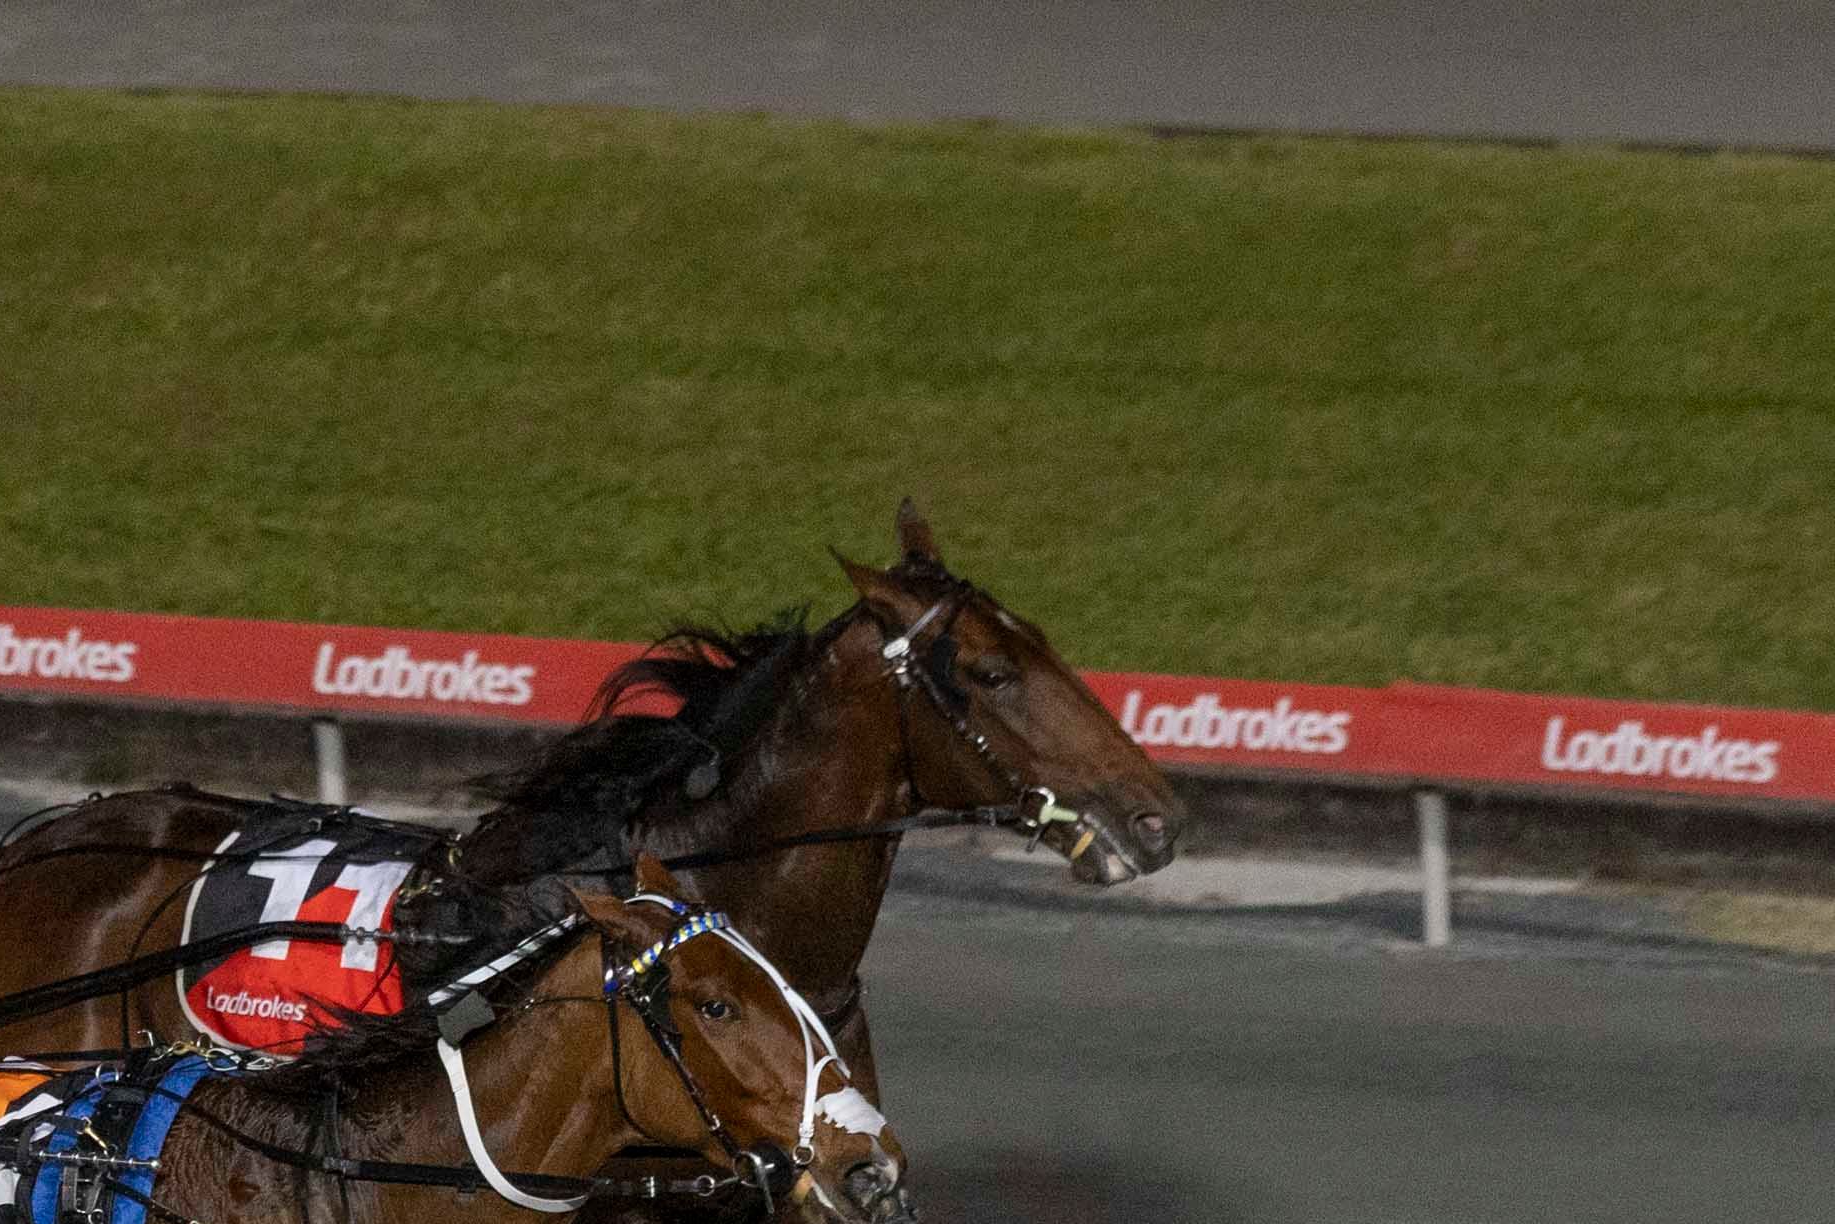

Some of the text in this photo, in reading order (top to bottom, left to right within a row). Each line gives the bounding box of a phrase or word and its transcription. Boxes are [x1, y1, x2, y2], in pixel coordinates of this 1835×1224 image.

[313, 642, 535, 706] Ladbrokes
[1120, 690, 1351, 754] Ladbrokes
[1542, 717, 1779, 783] Ladbrokes
[248, 839, 414, 973] 11
[206, 985, 308, 1021] Ladbrokes
